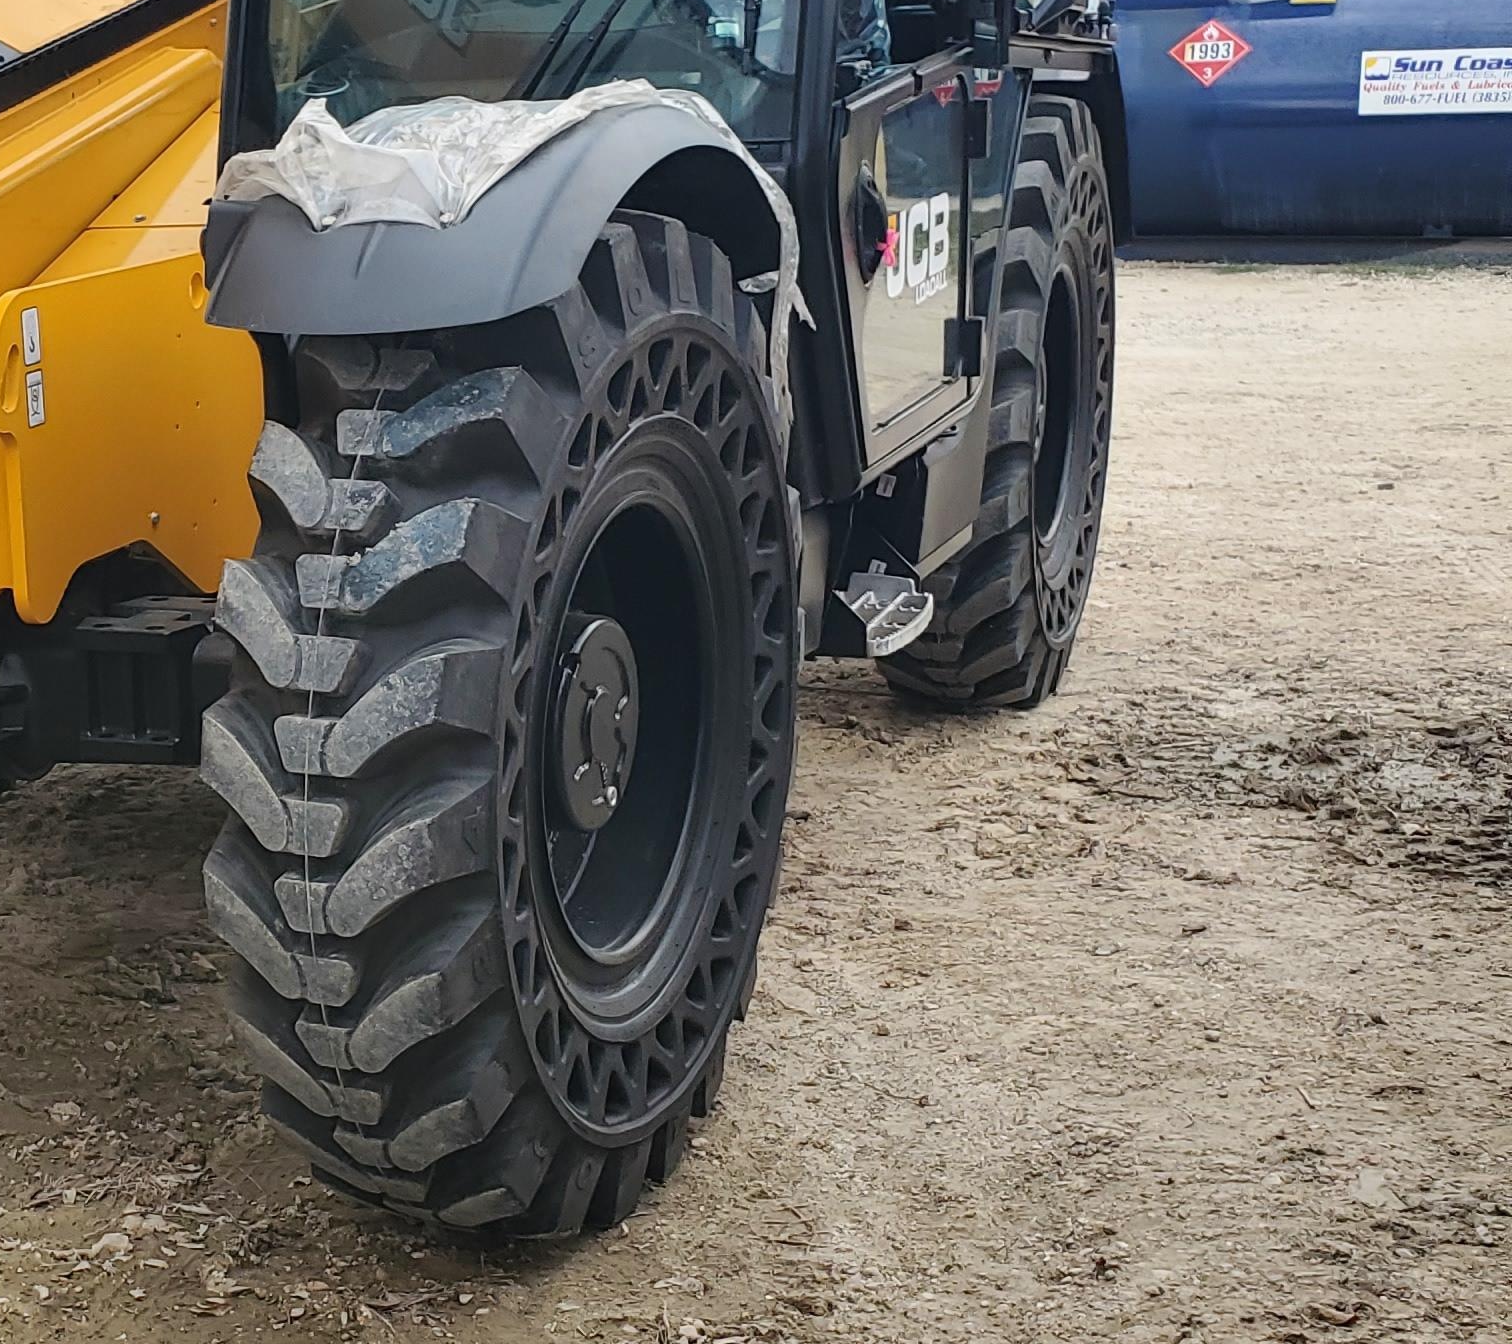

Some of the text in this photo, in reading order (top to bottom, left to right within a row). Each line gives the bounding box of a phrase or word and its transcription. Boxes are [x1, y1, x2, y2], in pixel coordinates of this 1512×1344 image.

[1189, 42, 1231, 61] 1993
[1202, 67, 1213, 79] 3
[1392, 58, 1443, 73] Sun
[1363, 81, 1407, 93] Quality
[1414, 81, 1445, 91] Fuels
[1451, 80, 1461, 90] &
[1383, 92, 1467, 105] 800-677-FUEL
[886, 192, 950, 298] JCB
[915, 269, 948, 305] LOADALL
